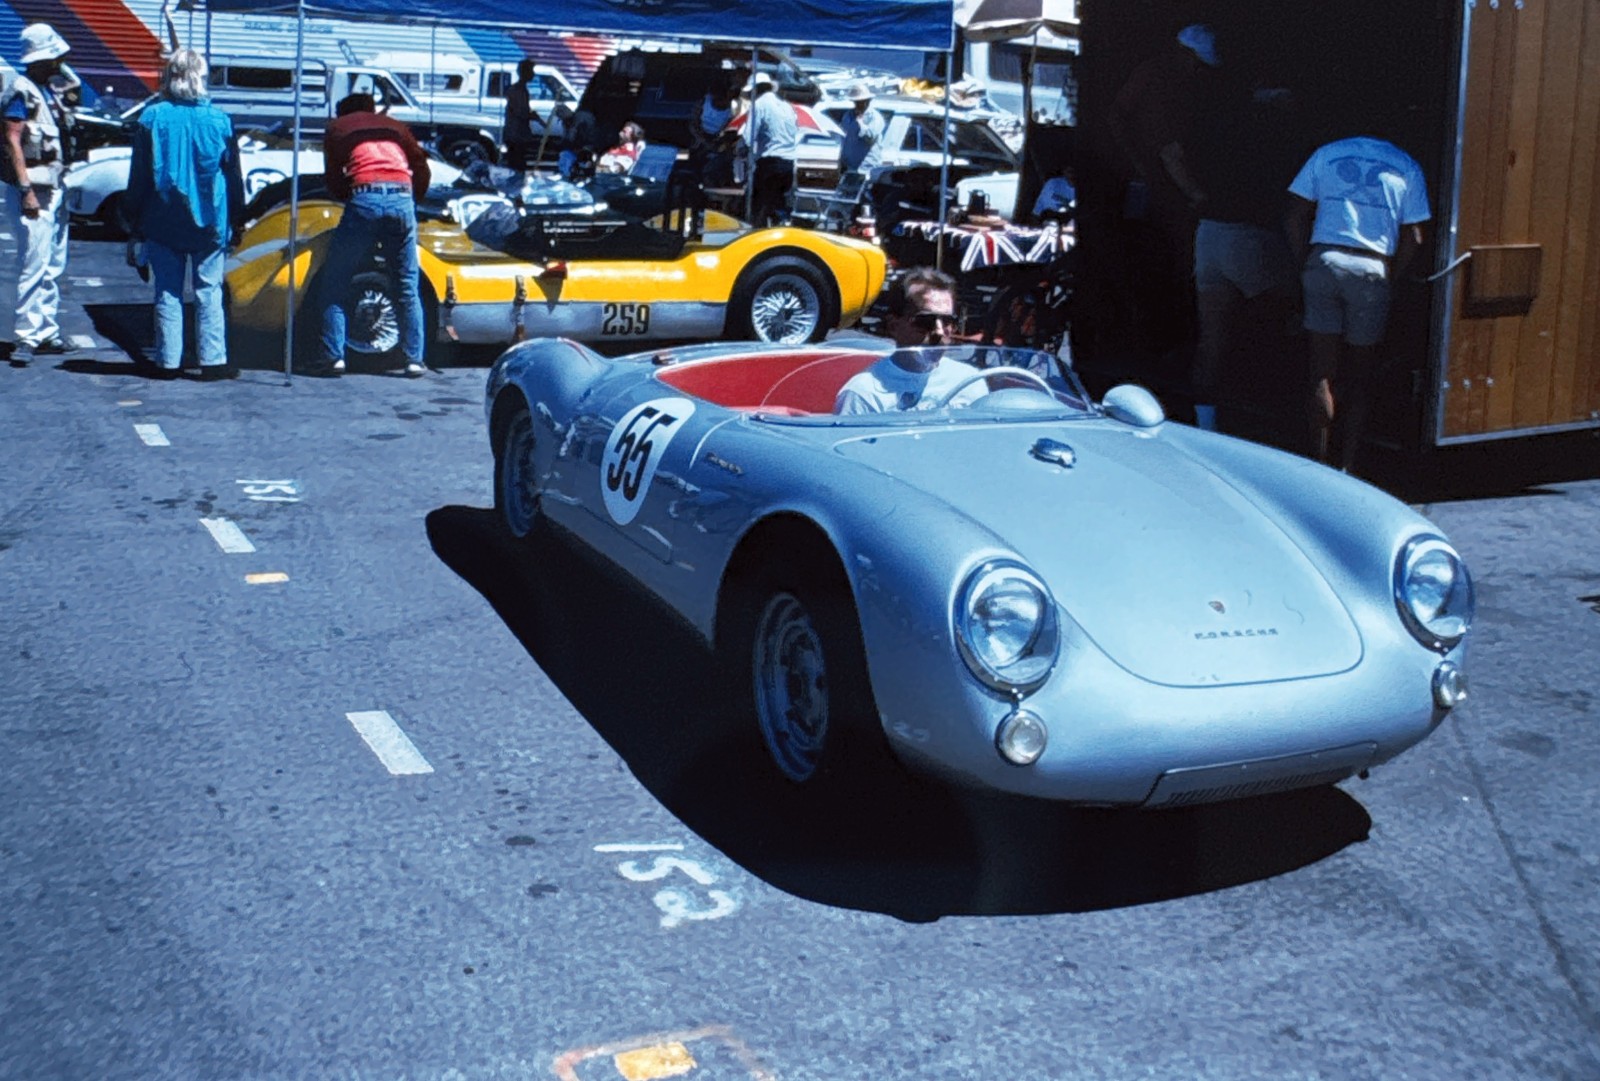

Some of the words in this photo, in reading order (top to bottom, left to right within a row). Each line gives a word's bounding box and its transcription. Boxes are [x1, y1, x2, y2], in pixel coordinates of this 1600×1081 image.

[601, 302, 650, 335] 259
[606, 405, 679, 502] 55
[1194, 628, 1279, 640] PORSCHE
